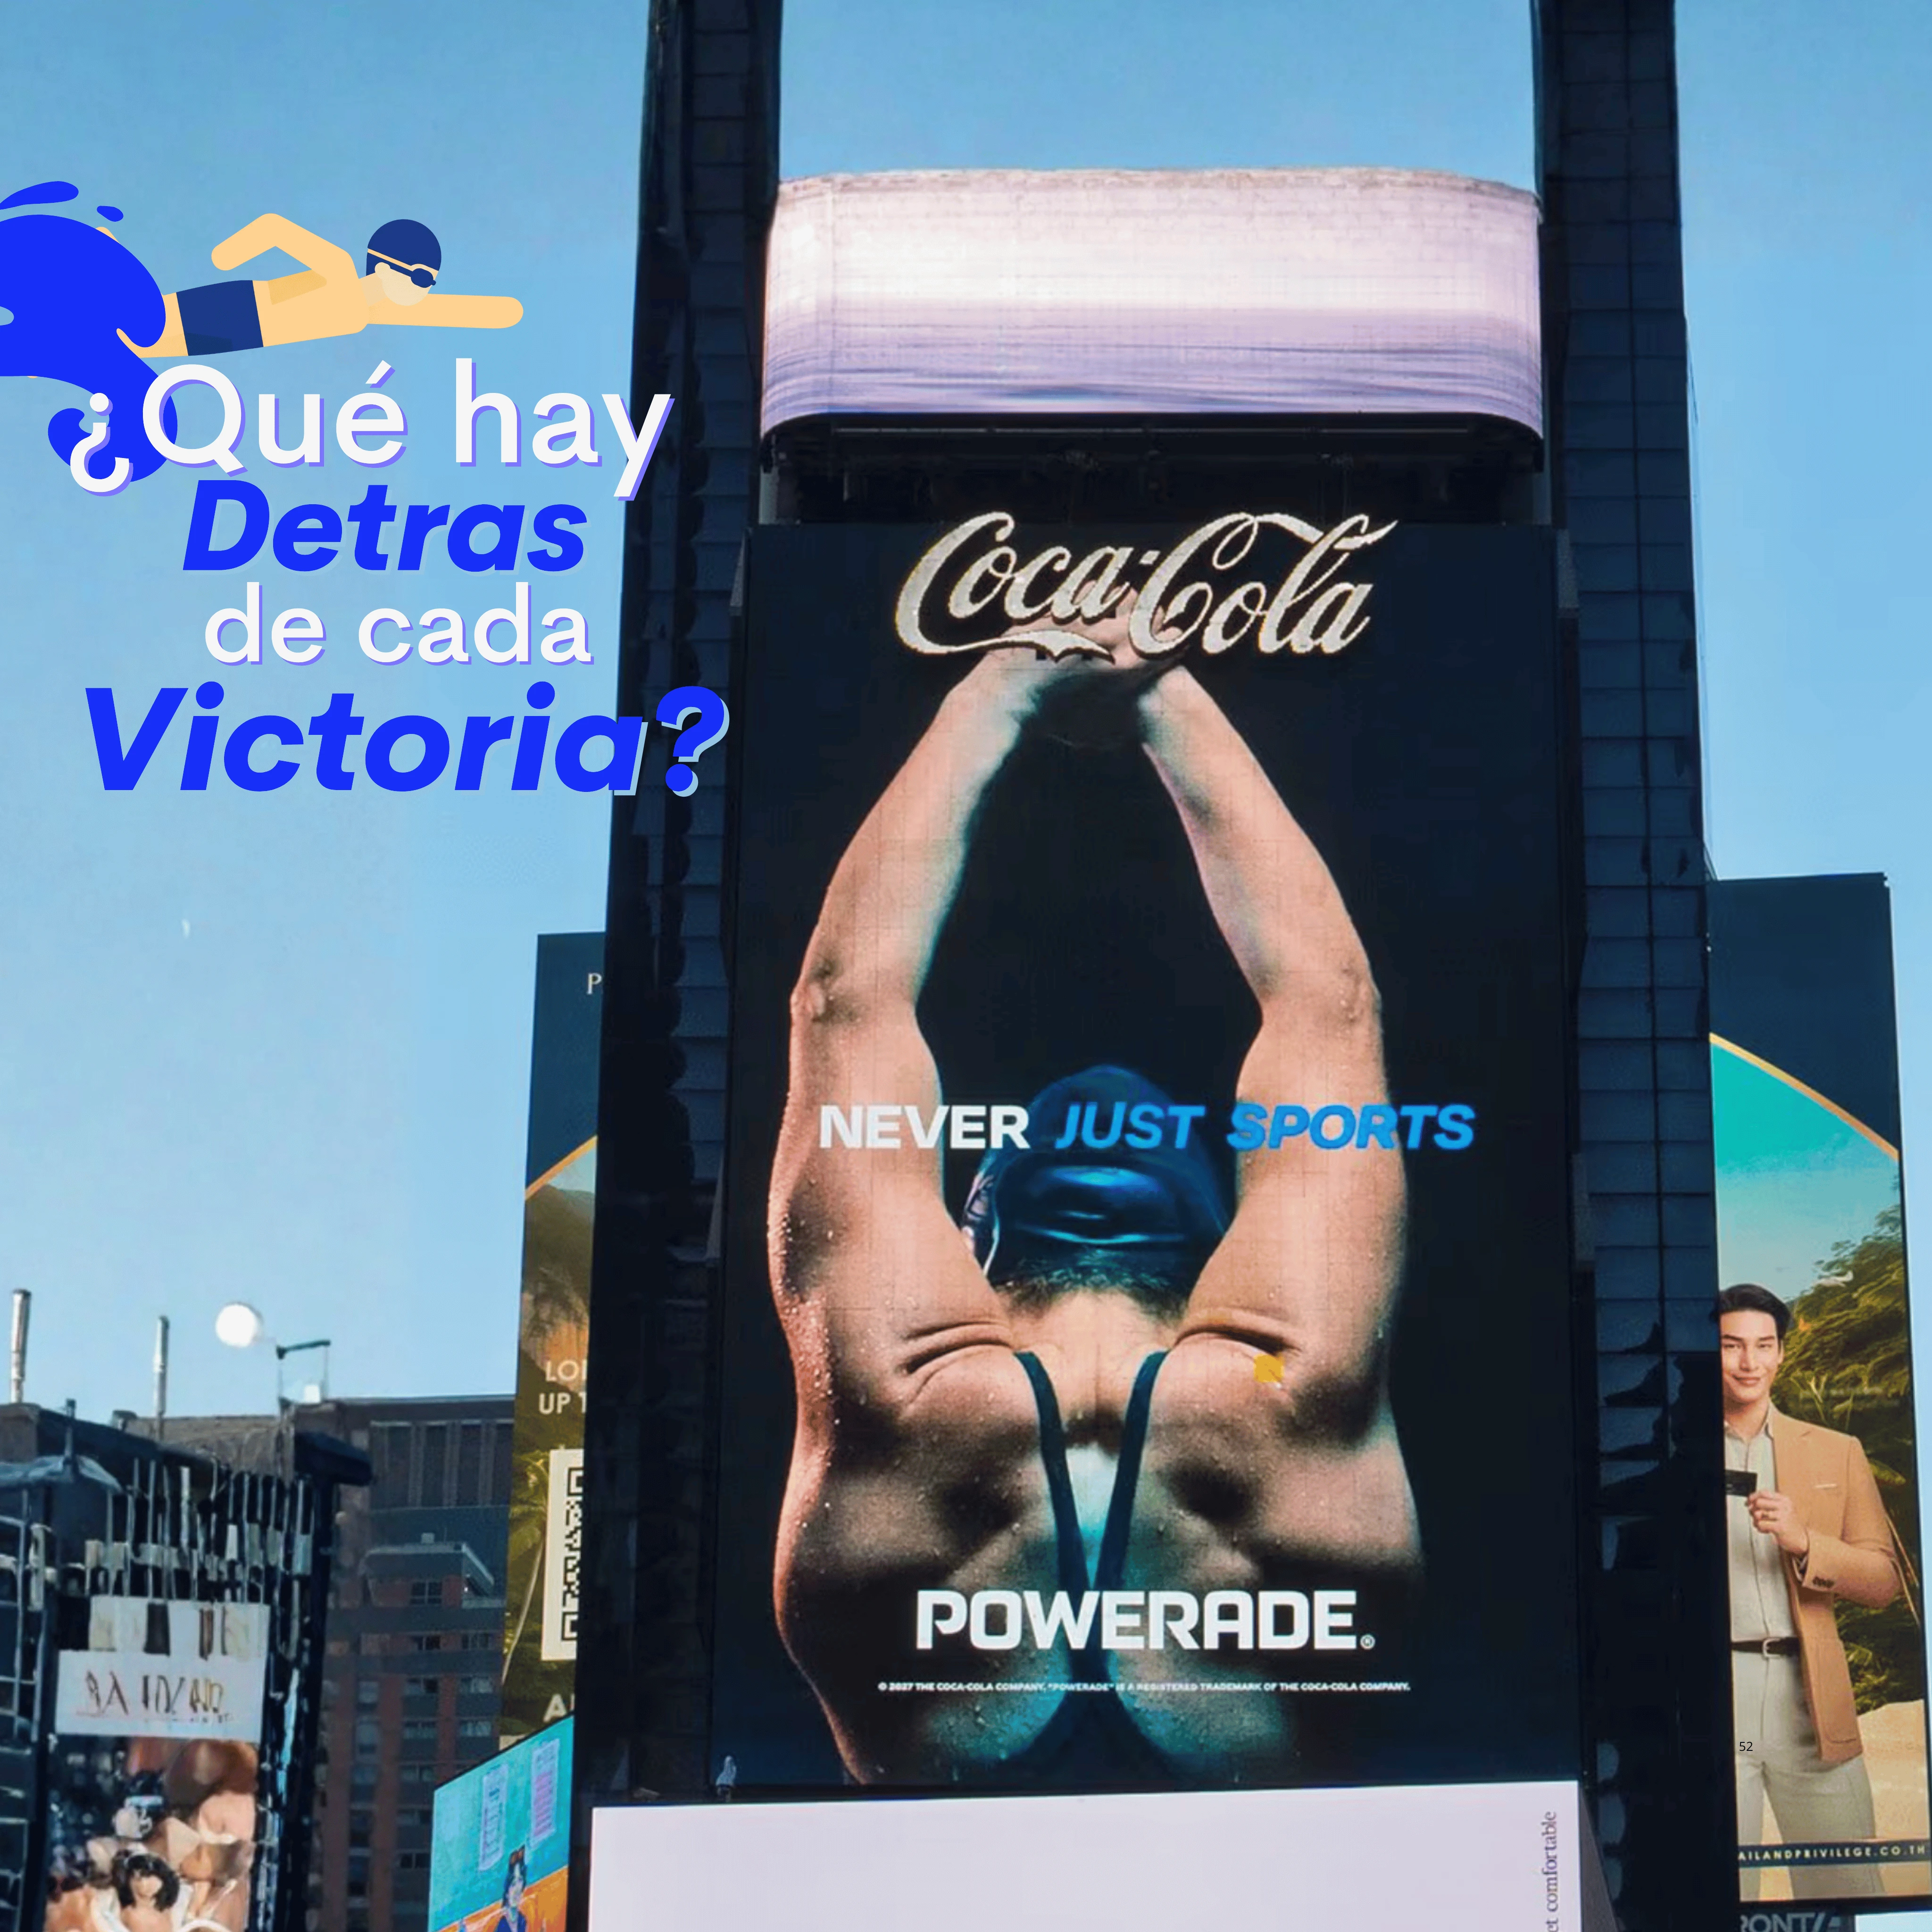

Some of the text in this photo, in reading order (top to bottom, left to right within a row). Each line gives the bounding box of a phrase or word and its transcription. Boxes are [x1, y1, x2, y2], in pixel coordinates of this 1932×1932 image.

[895, 511, 1398, 664] Coca-Cola
[820, 1102, 1475, 1150] NEVER JUST SPORTS
[539, 1392, 571, 1415] UP
[916, 1682, 934, 1692] THE
[936, 1682, 993, 1692] COCA-COLA
[1137, 1682, 1198, 1692] REGISTERED
[1200, 1682, 1262, 1692] TRADEMARK
[1264, 1682, 1277, 1692] OF
[1280, 1682, 1299, 1692] THE
[1300, 1682, 1357, 1692] COCA-COLA
[1541, 1811, 1558, 1912] comfortable
